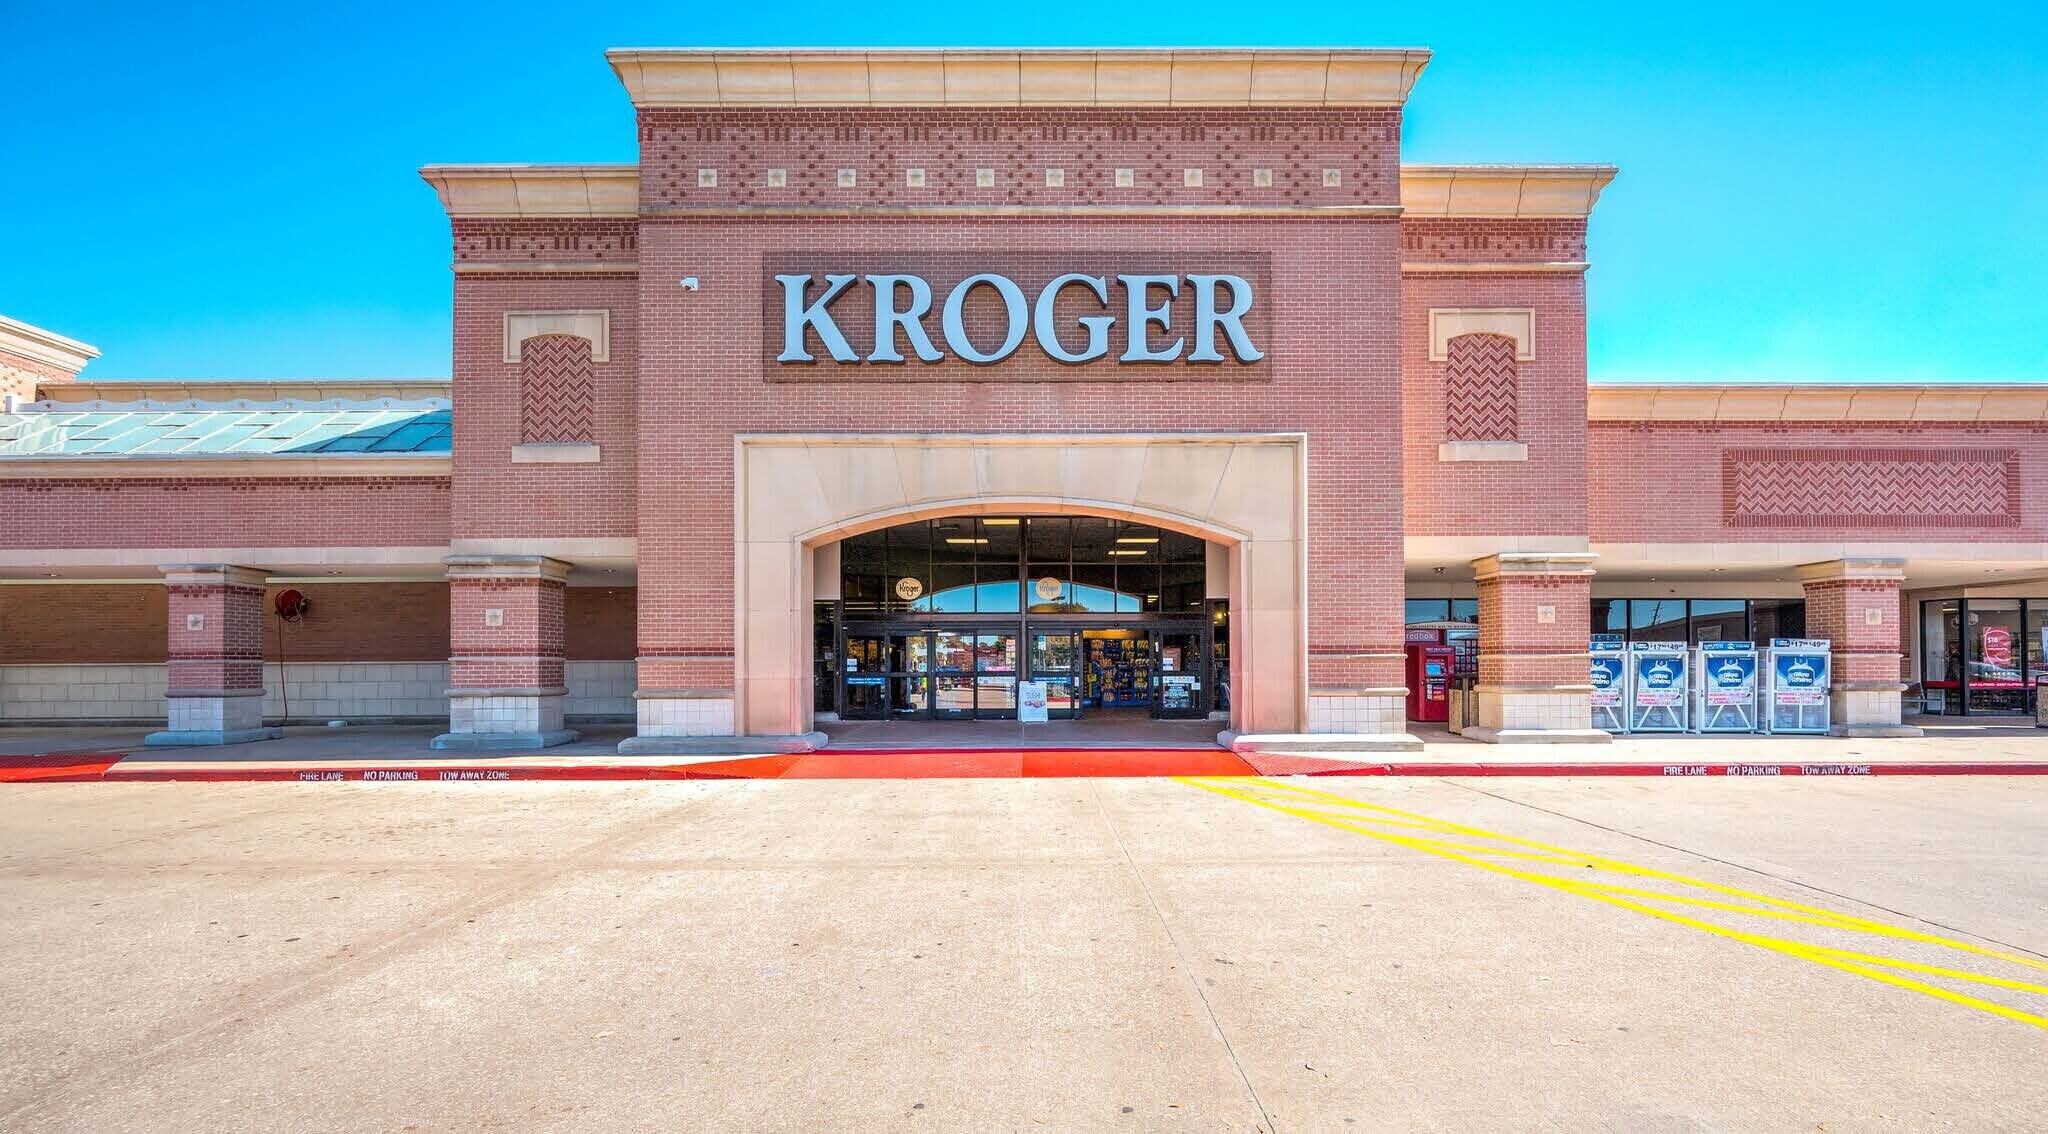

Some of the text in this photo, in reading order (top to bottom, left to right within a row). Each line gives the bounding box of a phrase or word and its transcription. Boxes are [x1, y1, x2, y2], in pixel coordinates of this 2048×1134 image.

[774, 273, 1264, 364] KROGER
[899, 581, 919, 596] Kroger
[1406, 632, 1434, 640] redbox
[439, 770, 510, 780] TOW AWAY ZONE
[1663, 766, 1707, 775] FIRE LANE
[1727, 766, 1780, 776] NO PARKING
[1801, 765, 1870, 775] TOW AWAY ZONE
[300, 772, 344, 781] FIRE LANE
[363, 771, 418, 780] NO PARKING
